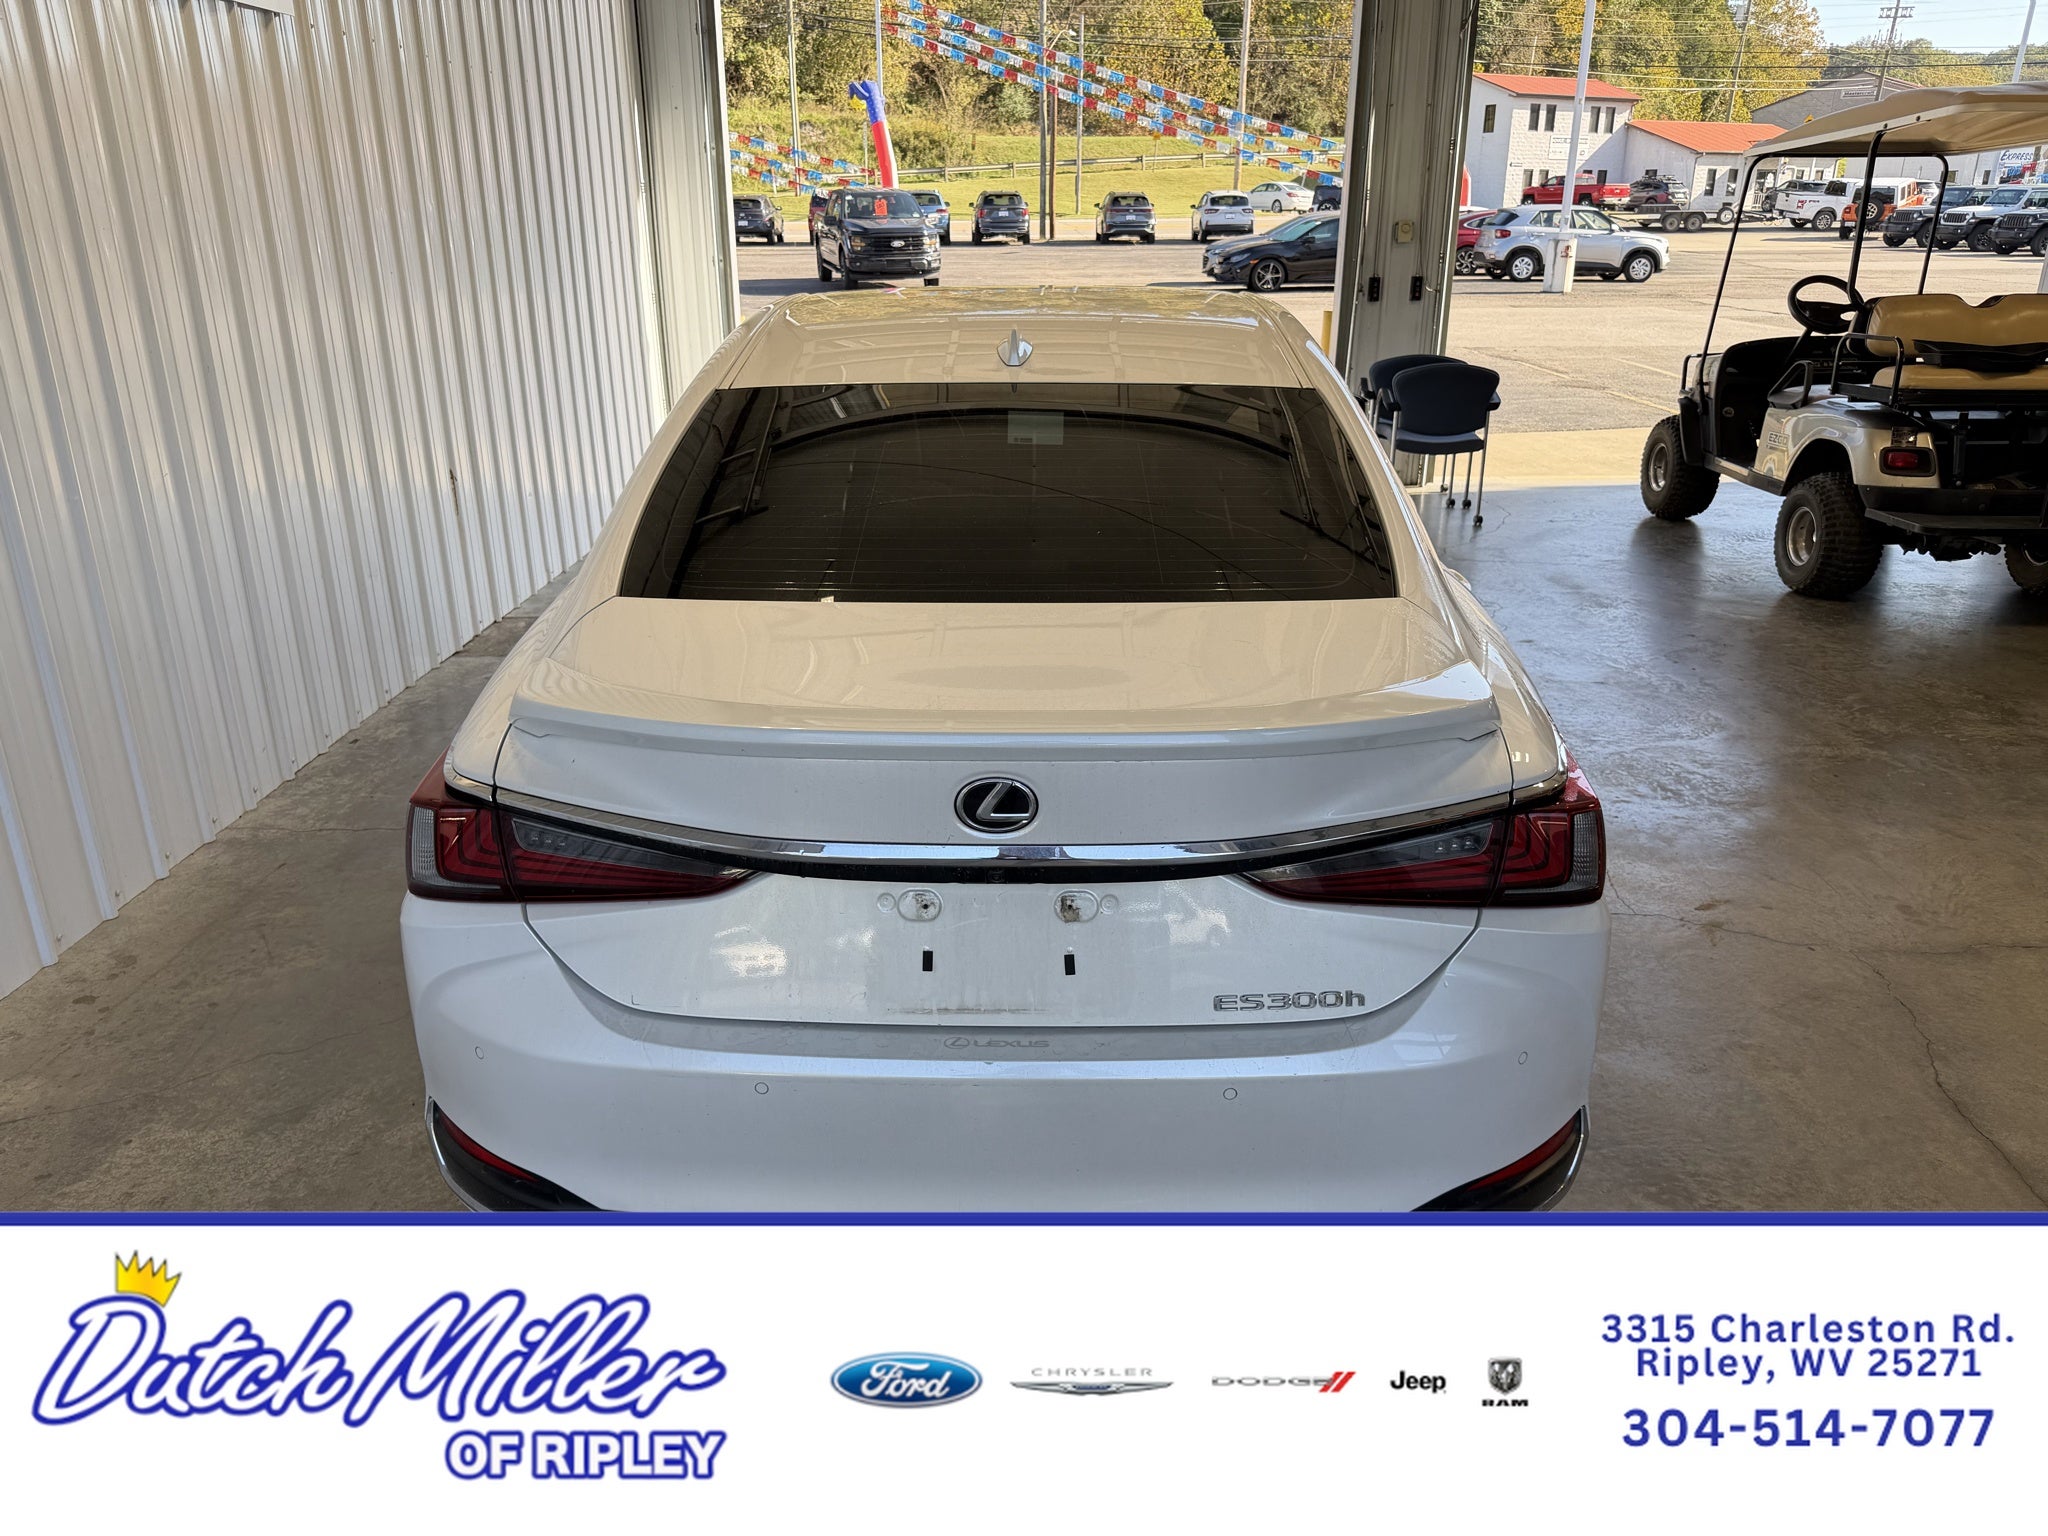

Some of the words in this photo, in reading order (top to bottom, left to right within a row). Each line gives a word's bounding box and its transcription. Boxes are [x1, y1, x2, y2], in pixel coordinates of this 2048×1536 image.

[2000, 150, 2034, 162] EXPRESS
[1213, 990, 1366, 1012] ES300h
[973, 1039, 1050, 1048] LEXUS
